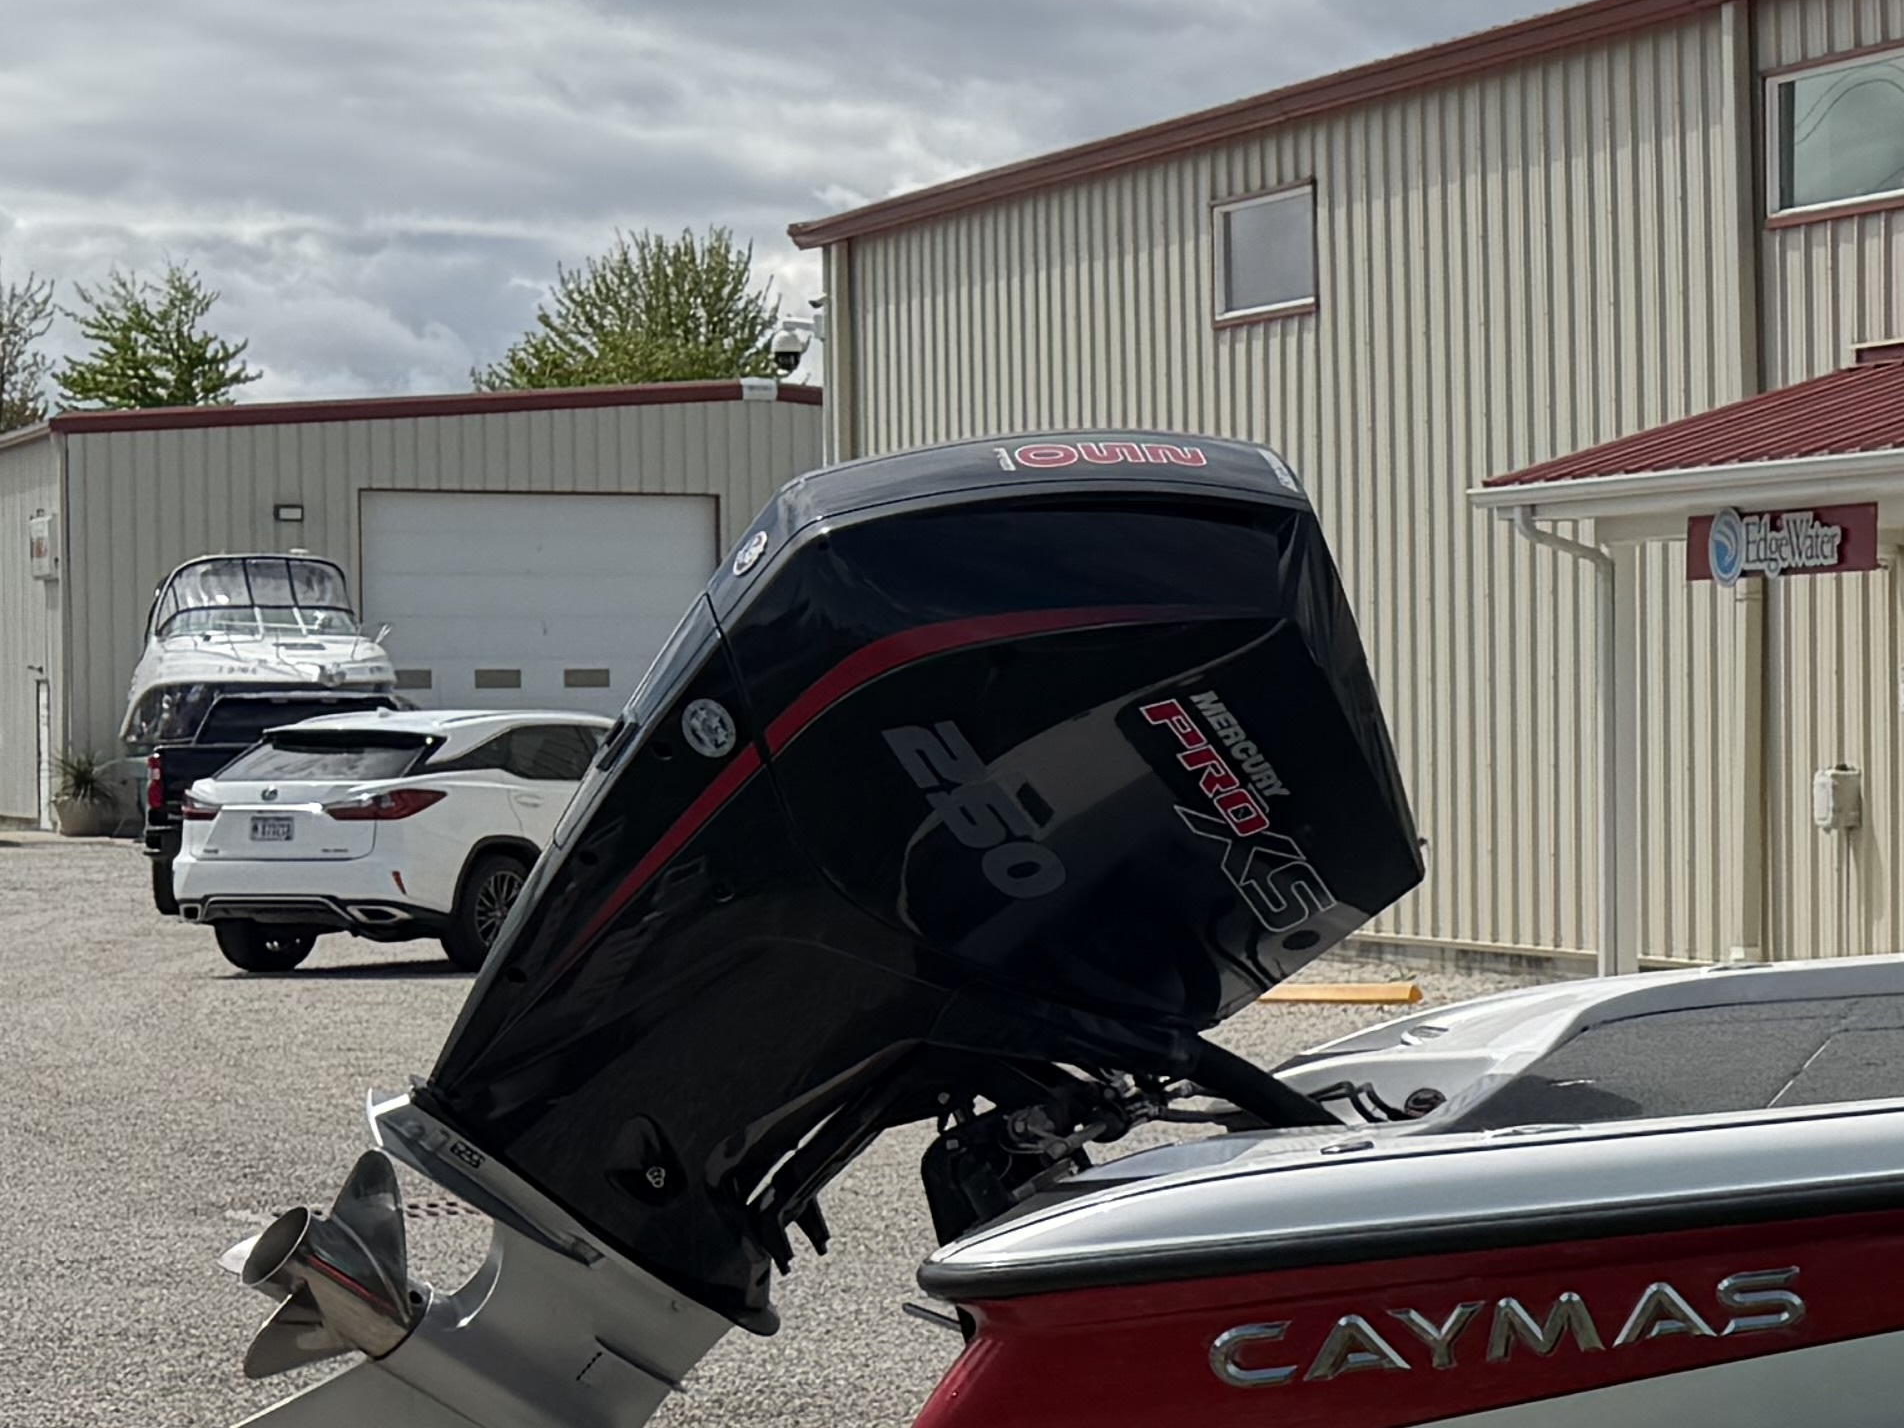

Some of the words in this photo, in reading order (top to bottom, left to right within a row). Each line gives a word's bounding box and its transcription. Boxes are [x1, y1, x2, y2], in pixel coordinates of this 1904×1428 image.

[1014, 442, 1208, 468] 250
[1744, 515, 1841, 573] EdgeWater
[1139, 698, 1270, 837] PRO
[1189, 690, 1291, 797] MERCURY
[880, 719, 1067, 899] 250
[1172, 804, 1338, 932] XS
[1208, 1265, 1806, 1387] CAYMAS
